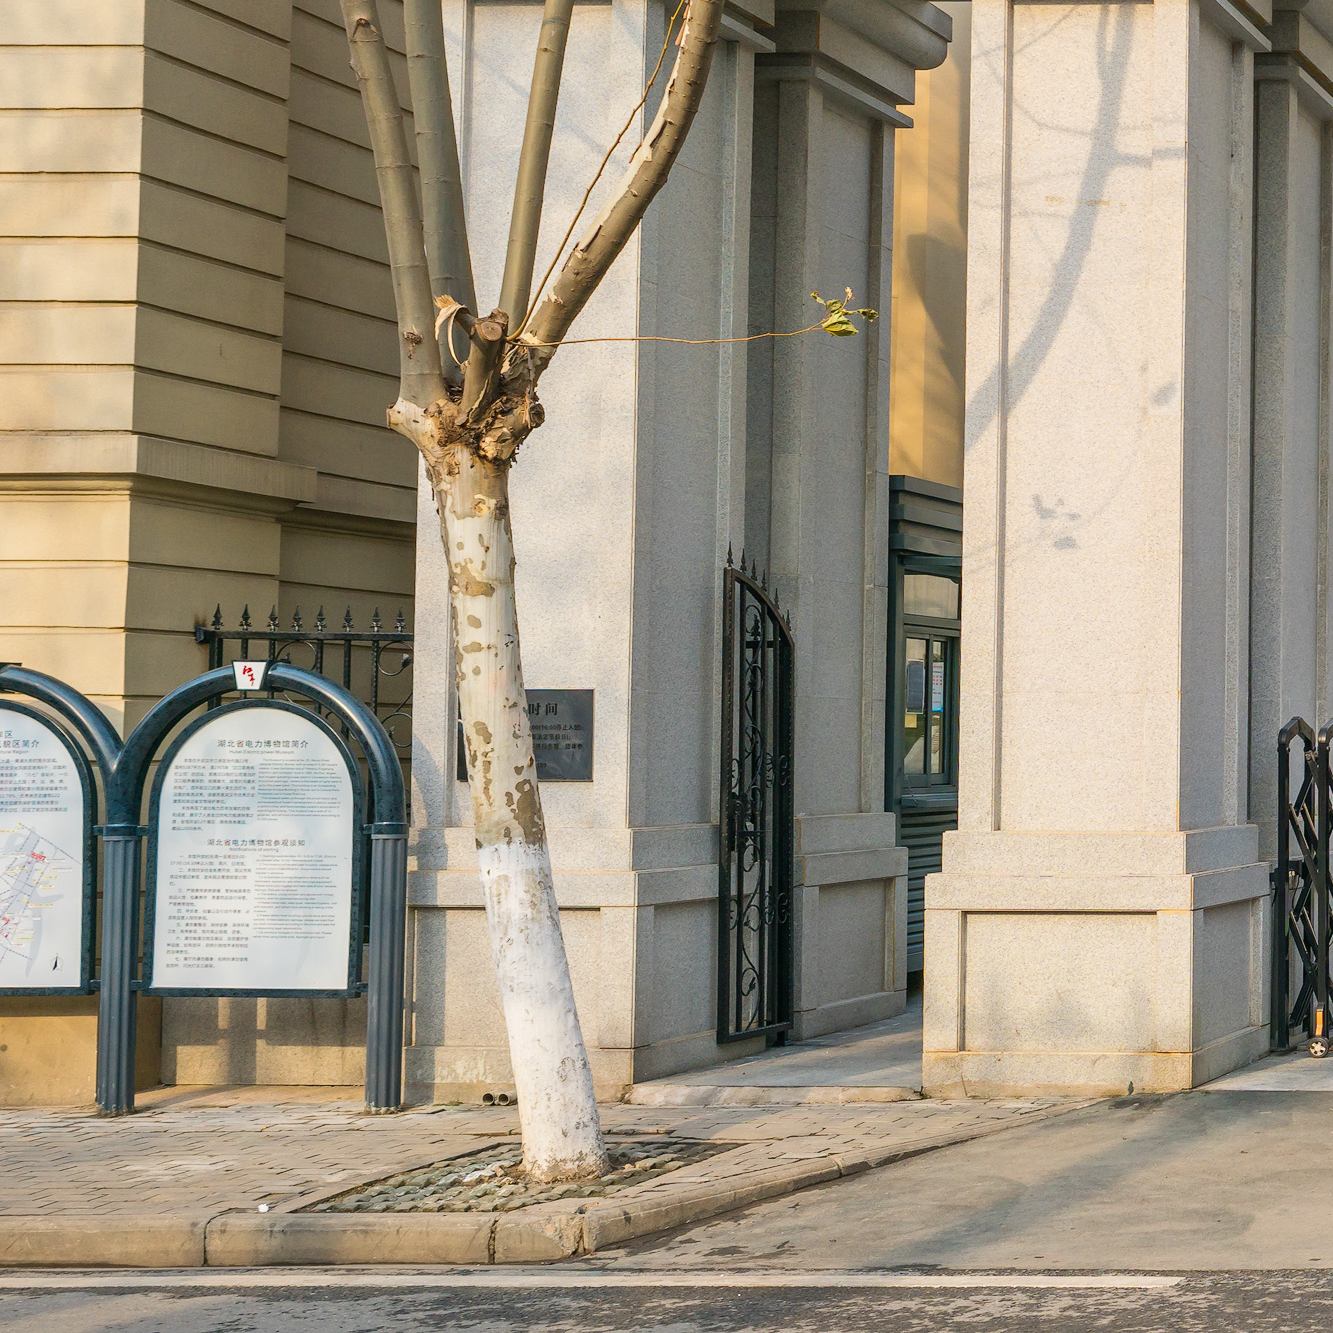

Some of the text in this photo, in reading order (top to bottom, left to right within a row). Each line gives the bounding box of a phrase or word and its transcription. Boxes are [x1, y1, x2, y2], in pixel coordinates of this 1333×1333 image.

[0, 739, 40, 748] 貌区简介
[217, 739, 309, 749] 湖北省电力博物馆简介
[207, 838, 306, 847] 湖北省电力博物馆参观须知
